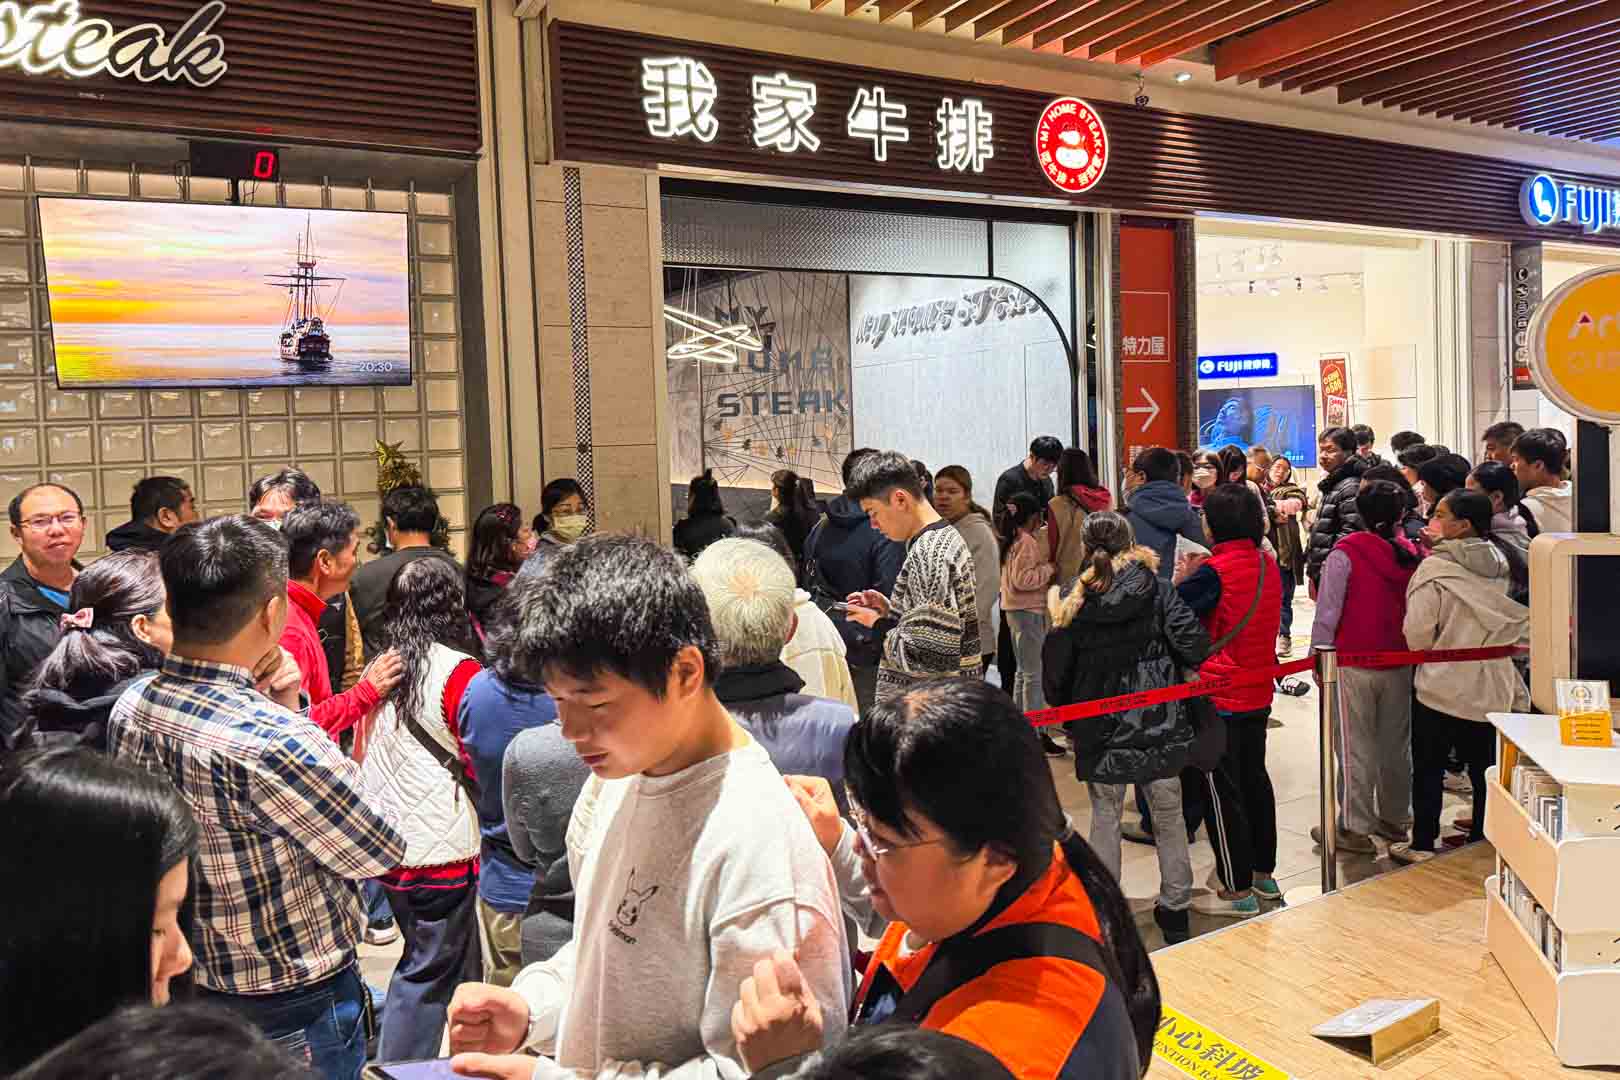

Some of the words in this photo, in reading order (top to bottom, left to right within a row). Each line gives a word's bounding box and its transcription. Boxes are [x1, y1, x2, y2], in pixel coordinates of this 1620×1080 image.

[642, 57, 994, 173] 我家牛排
[1040, 120, 1050, 142] MY
[1047, 103, 1078, 122] HOME
[1079, 108, 1103, 148] STEAK
[254, 151, 274, 178] 0
[1567, 311, 1620, 340] Ar
[1122, 336, 1166, 356] 特力屋
[360, 362, 393, 373] 20:30
[717, 391, 850, 418] STEAK
[1160, 1016, 1265, 1080] 小心斜坡
